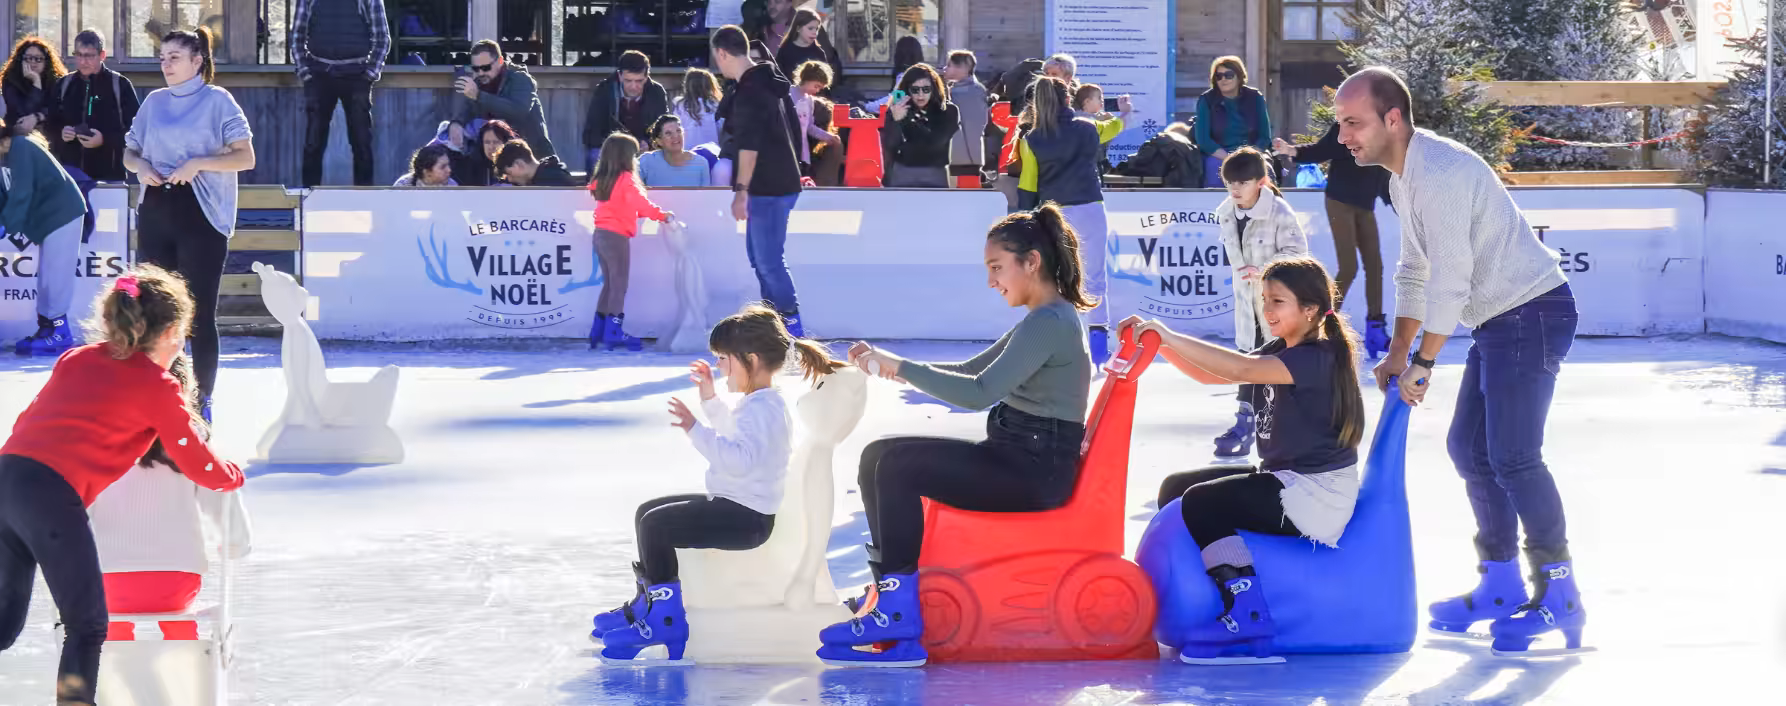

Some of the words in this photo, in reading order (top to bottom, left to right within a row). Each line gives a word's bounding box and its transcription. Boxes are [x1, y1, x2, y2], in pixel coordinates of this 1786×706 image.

[469, 223, 485, 236] LE
[489, 219, 566, 234] BARCARÈS
[1140, 215, 1156, 228] LE
[1160, 211, 1221, 225] BARCAR
[466, 244, 573, 277] VILLAGE
[1160, 269, 1218, 296] NOËL
[490, 278, 552, 306] NOËL
[1148, 303, 1193, 316] DEPUIS
[1200, 302, 1229, 315] 1999
[478, 313, 525, 326] DEPUIS
[533, 312, 562, 325] 1999
